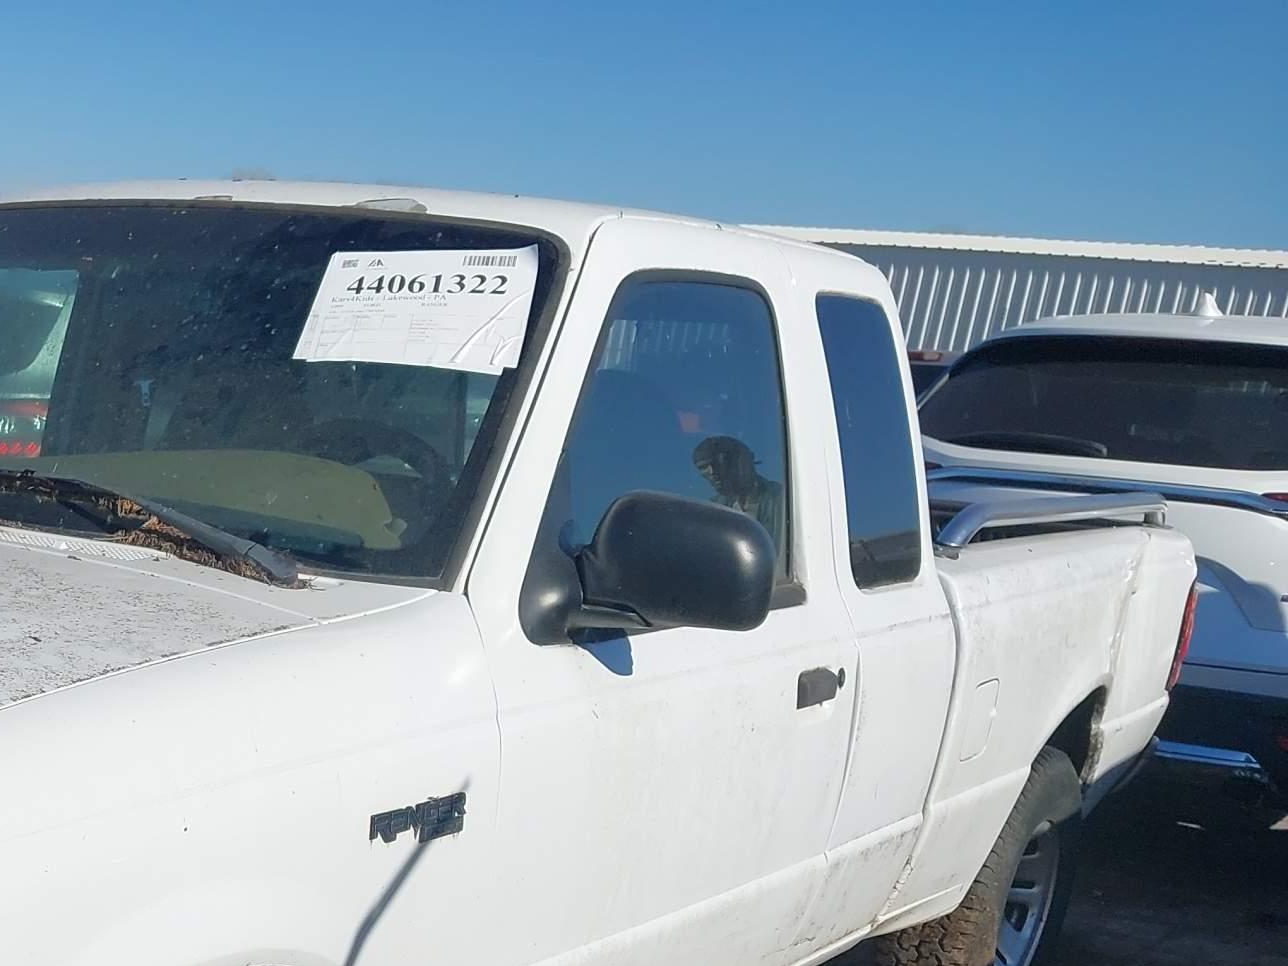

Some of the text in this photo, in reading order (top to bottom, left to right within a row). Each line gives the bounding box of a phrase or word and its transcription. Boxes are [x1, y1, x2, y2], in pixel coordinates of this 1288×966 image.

[347, 274, 508, 295] 44061322
[382, 294, 426, 302] Lakewood
[369, 792, 467, 843] RANGER
